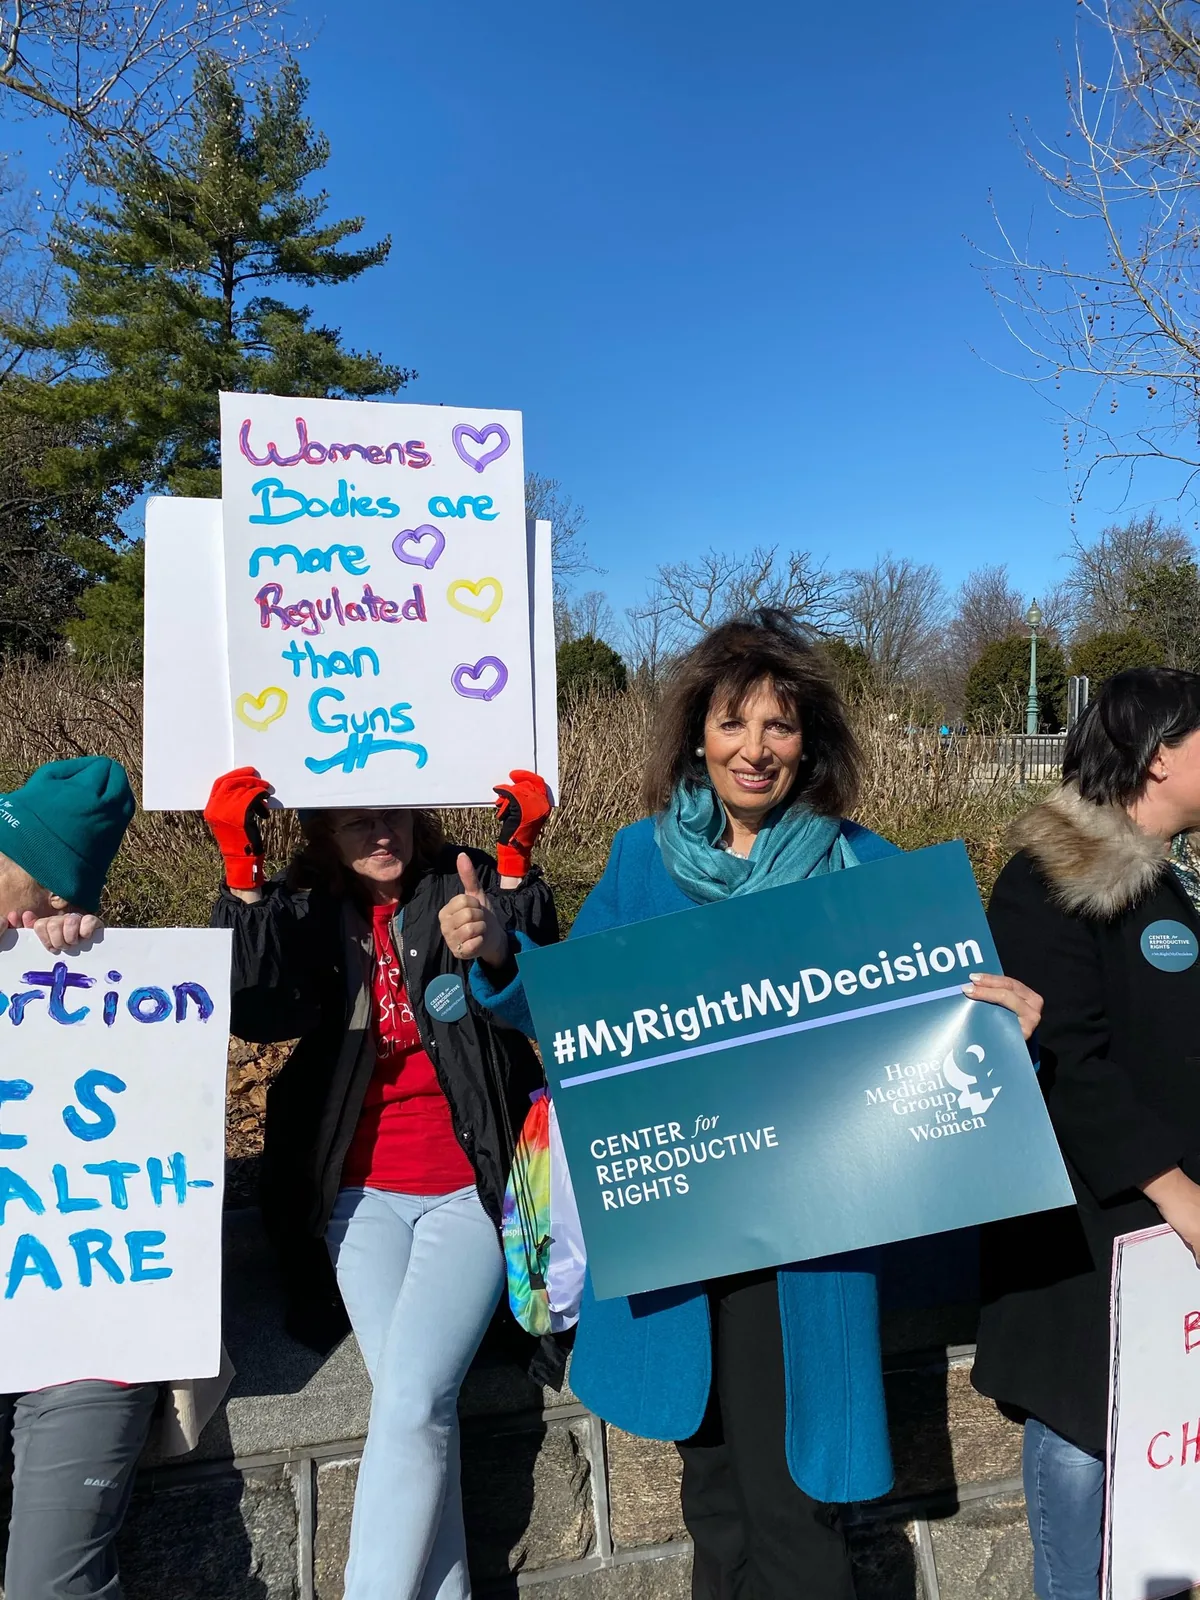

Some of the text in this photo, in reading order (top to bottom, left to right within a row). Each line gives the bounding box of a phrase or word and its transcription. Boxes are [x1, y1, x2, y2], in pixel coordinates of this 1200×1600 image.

[248, 477, 500, 525] Bodies are
[249, 543, 371, 578] more
[255, 583, 427, 635] Regulated
[281, 640, 380, 678] than
[308, 686, 416, 735] Guns
[0, 962, 214, 1027] rtion
[553, 939, 984, 1064] #MyRightMyDecision
[864, 1073, 945, 1106] Medical
[884, 1060, 942, 1082] Hope
[892, 1091, 957, 1116] Group
[935, 1110, 958, 1125] for
[590, 1114, 720, 1160] CENTER for
[908, 1116, 987, 1143] Women
[595, 1126, 779, 1186] REPRODUCTIVE
[601, 1173, 691, 1212] RIGHTS
